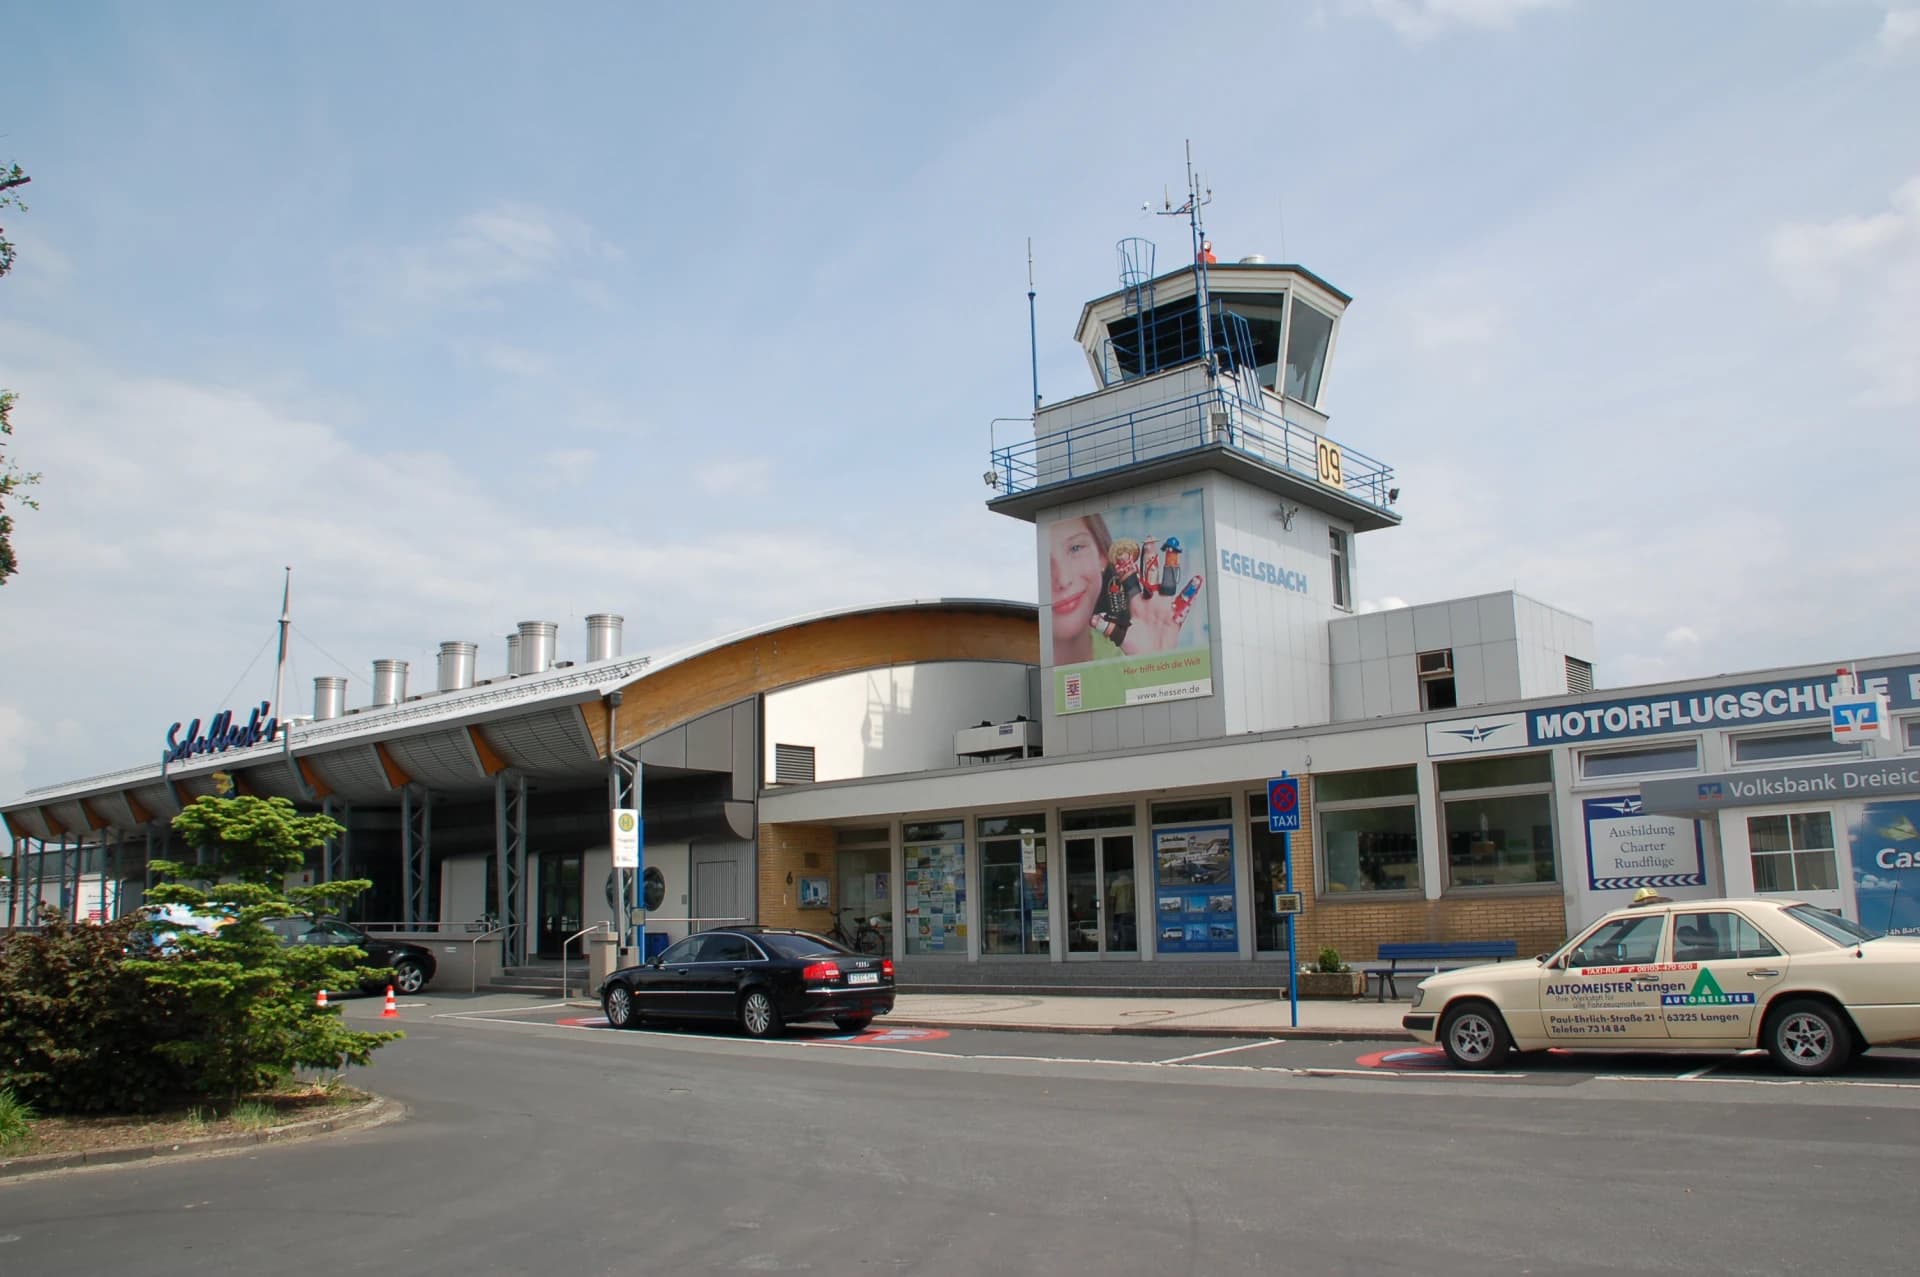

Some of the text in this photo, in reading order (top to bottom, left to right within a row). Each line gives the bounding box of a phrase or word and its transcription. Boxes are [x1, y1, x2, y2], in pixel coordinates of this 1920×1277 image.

[1320, 444, 1340, 484] 09
[1221, 549, 1307, 594] EGELSBACH
[1123, 658, 1201, 675] Hier trifft sich die Welt
[1137, 684, 1200, 701] www.hessen.de
[1729, 767, 1920, 798] Volksbank Dreieic
[1272, 815, 1297, 827] TAXI
[1609, 824, 1675, 838] Ausbildung
[1620, 841, 1666, 853] Charter
[1614, 856, 1675, 869] Rundflüge
[786, 871, 794, 886] 6
[1586, 966, 1620, 975] TAXI-RUF
[1546, 983, 1686, 995] AUTOMEISTER Langen
[1665, 995, 1750, 1004] AUTOMEISTER
[1550, 1013, 1739, 1024] Paul-Ehrlich-Straße 21 63225 Langen
[1551, 1025, 1585, 1033] Telefon
[1588, 1025, 1600, 1033] 73
[1613, 1024, 1626, 1032] 84
